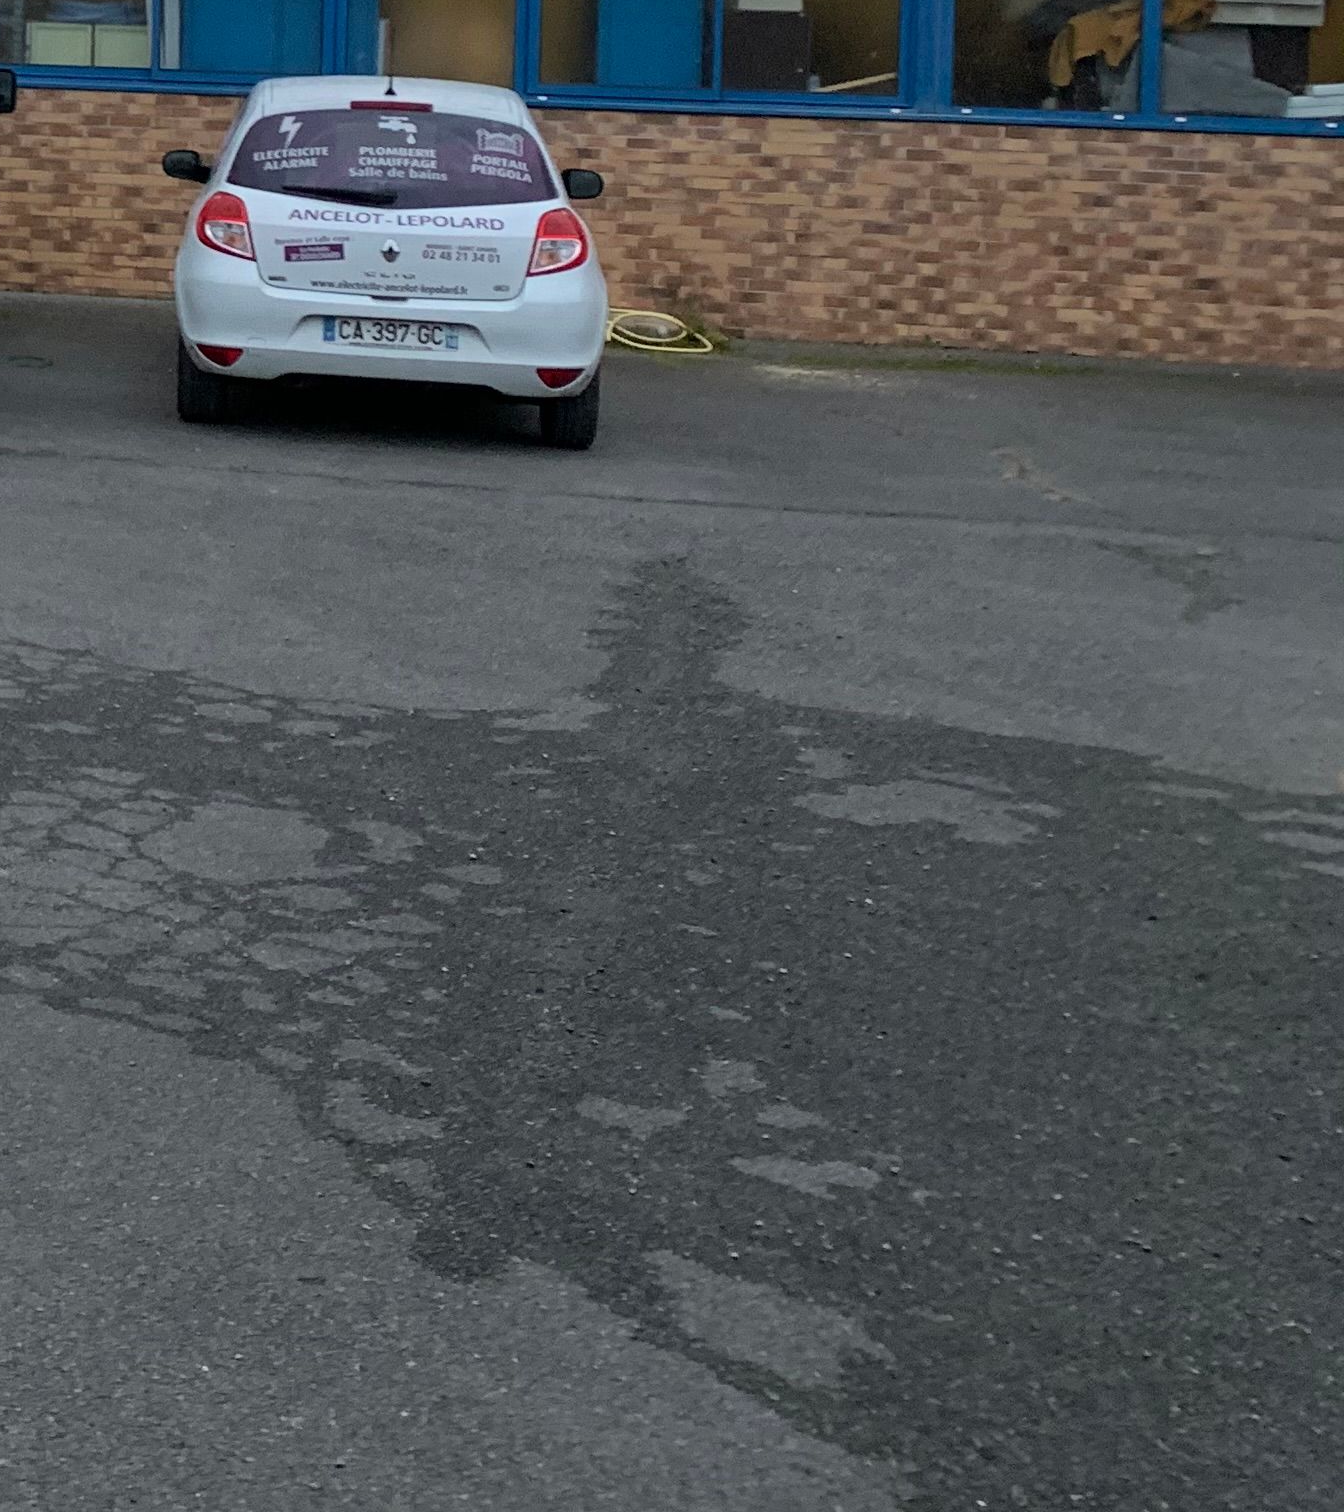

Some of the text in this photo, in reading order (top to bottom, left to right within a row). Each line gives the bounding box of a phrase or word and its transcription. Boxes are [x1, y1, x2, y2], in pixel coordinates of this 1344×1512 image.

[253, 146, 329, 162] ELECTRICITE
[359, 146, 438, 159] PLOMBERIE
[263, 158, 319, 172] ALARME
[358, 156, 439, 170] CHAUFFAGE
[472, 154, 530, 172] PORTAIL
[348, 166, 448, 182] Salle de bains
[470, 164, 533, 184] PERGOLA
[289, 208, 385, 225] ANCELOT
[397, 214, 505, 231] LEPOLARD
[421, 249, 436, 260] 02
[338, 320, 445, 346] CA-397-GC
